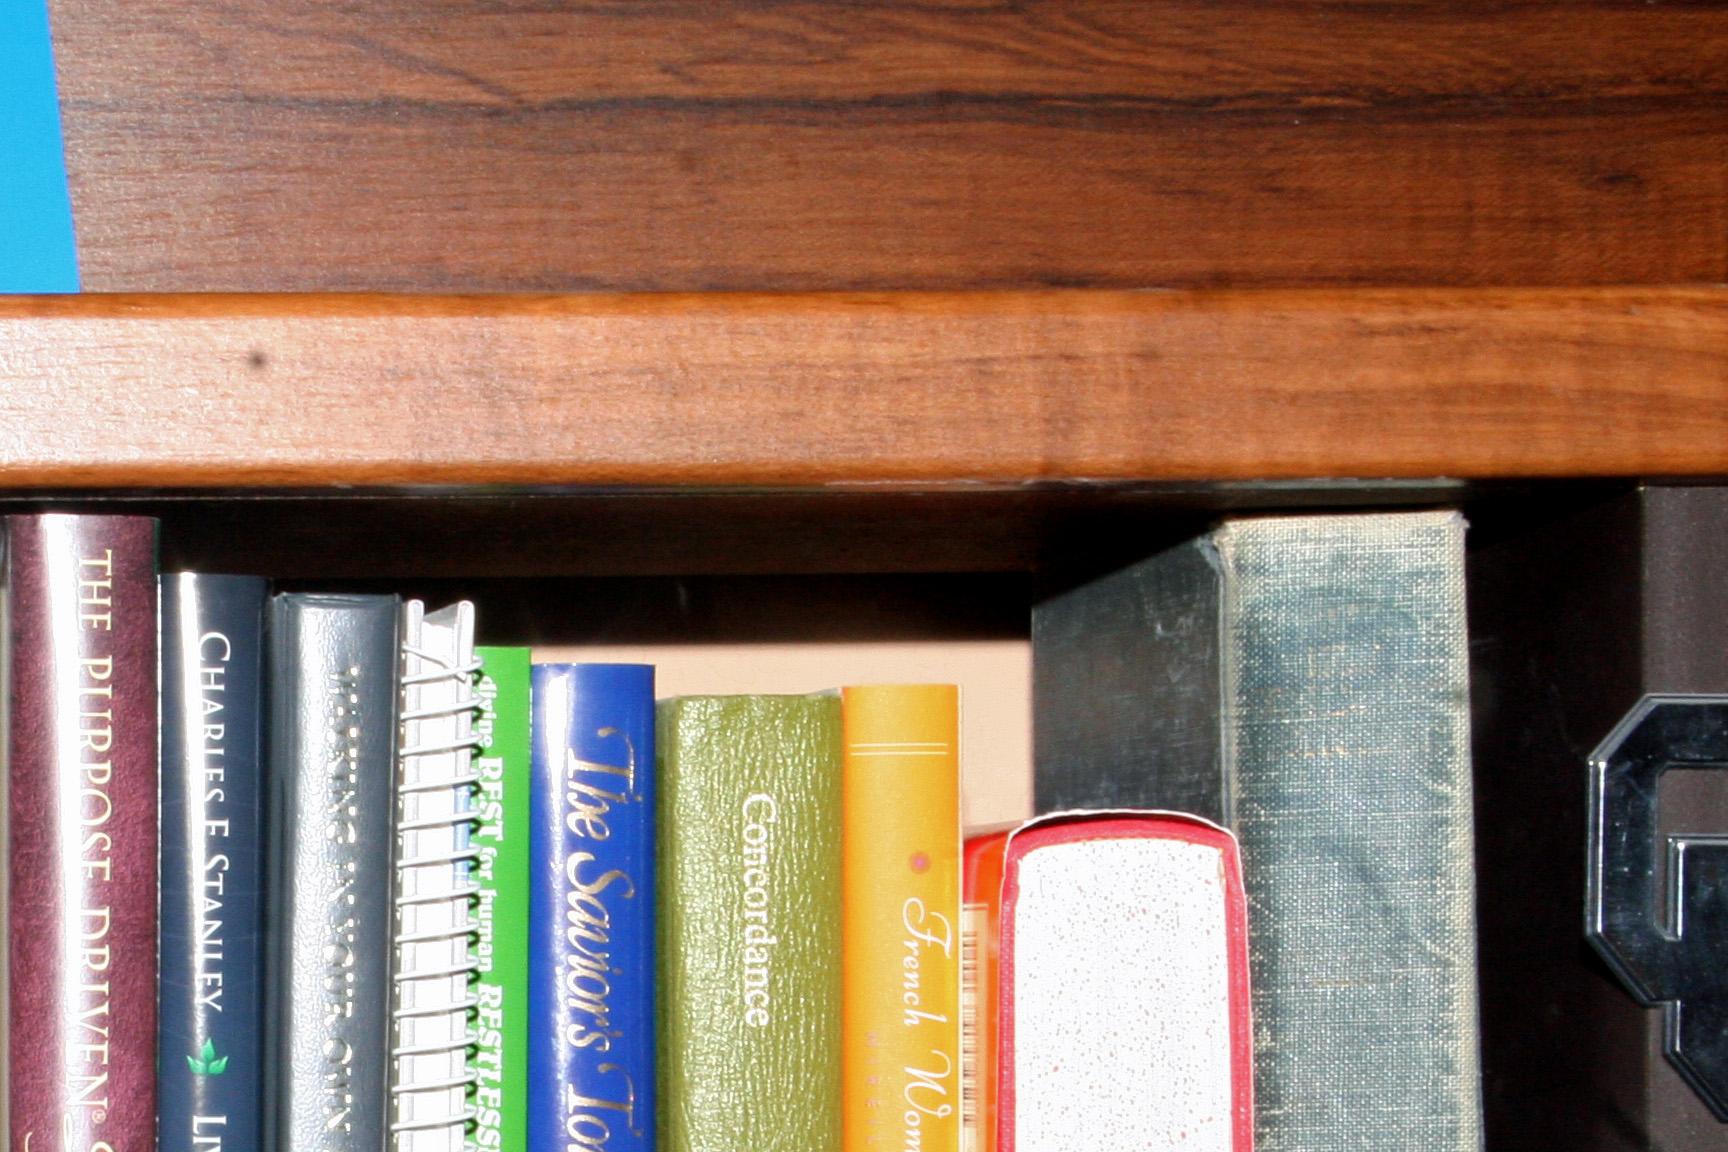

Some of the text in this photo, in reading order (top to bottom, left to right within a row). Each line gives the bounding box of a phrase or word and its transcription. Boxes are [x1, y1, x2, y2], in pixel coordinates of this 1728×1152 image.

[77, 549, 113, 631] THE
[73, 655, 113, 881] PURPOSE
[197, 631, 232, 802] CHARLES
[477, 676, 498, 748] divine
[478, 757, 504, 841] REST
[568, 727, 643, 842] The
[478, 847, 498, 881] for
[742, 793, 777, 1028] Concordance
[198, 853, 229, 1013] STANLEY
[478, 889, 498, 972] human
[565, 853, 635, 1053] Savior's
[901, 897, 952, 1027] French
